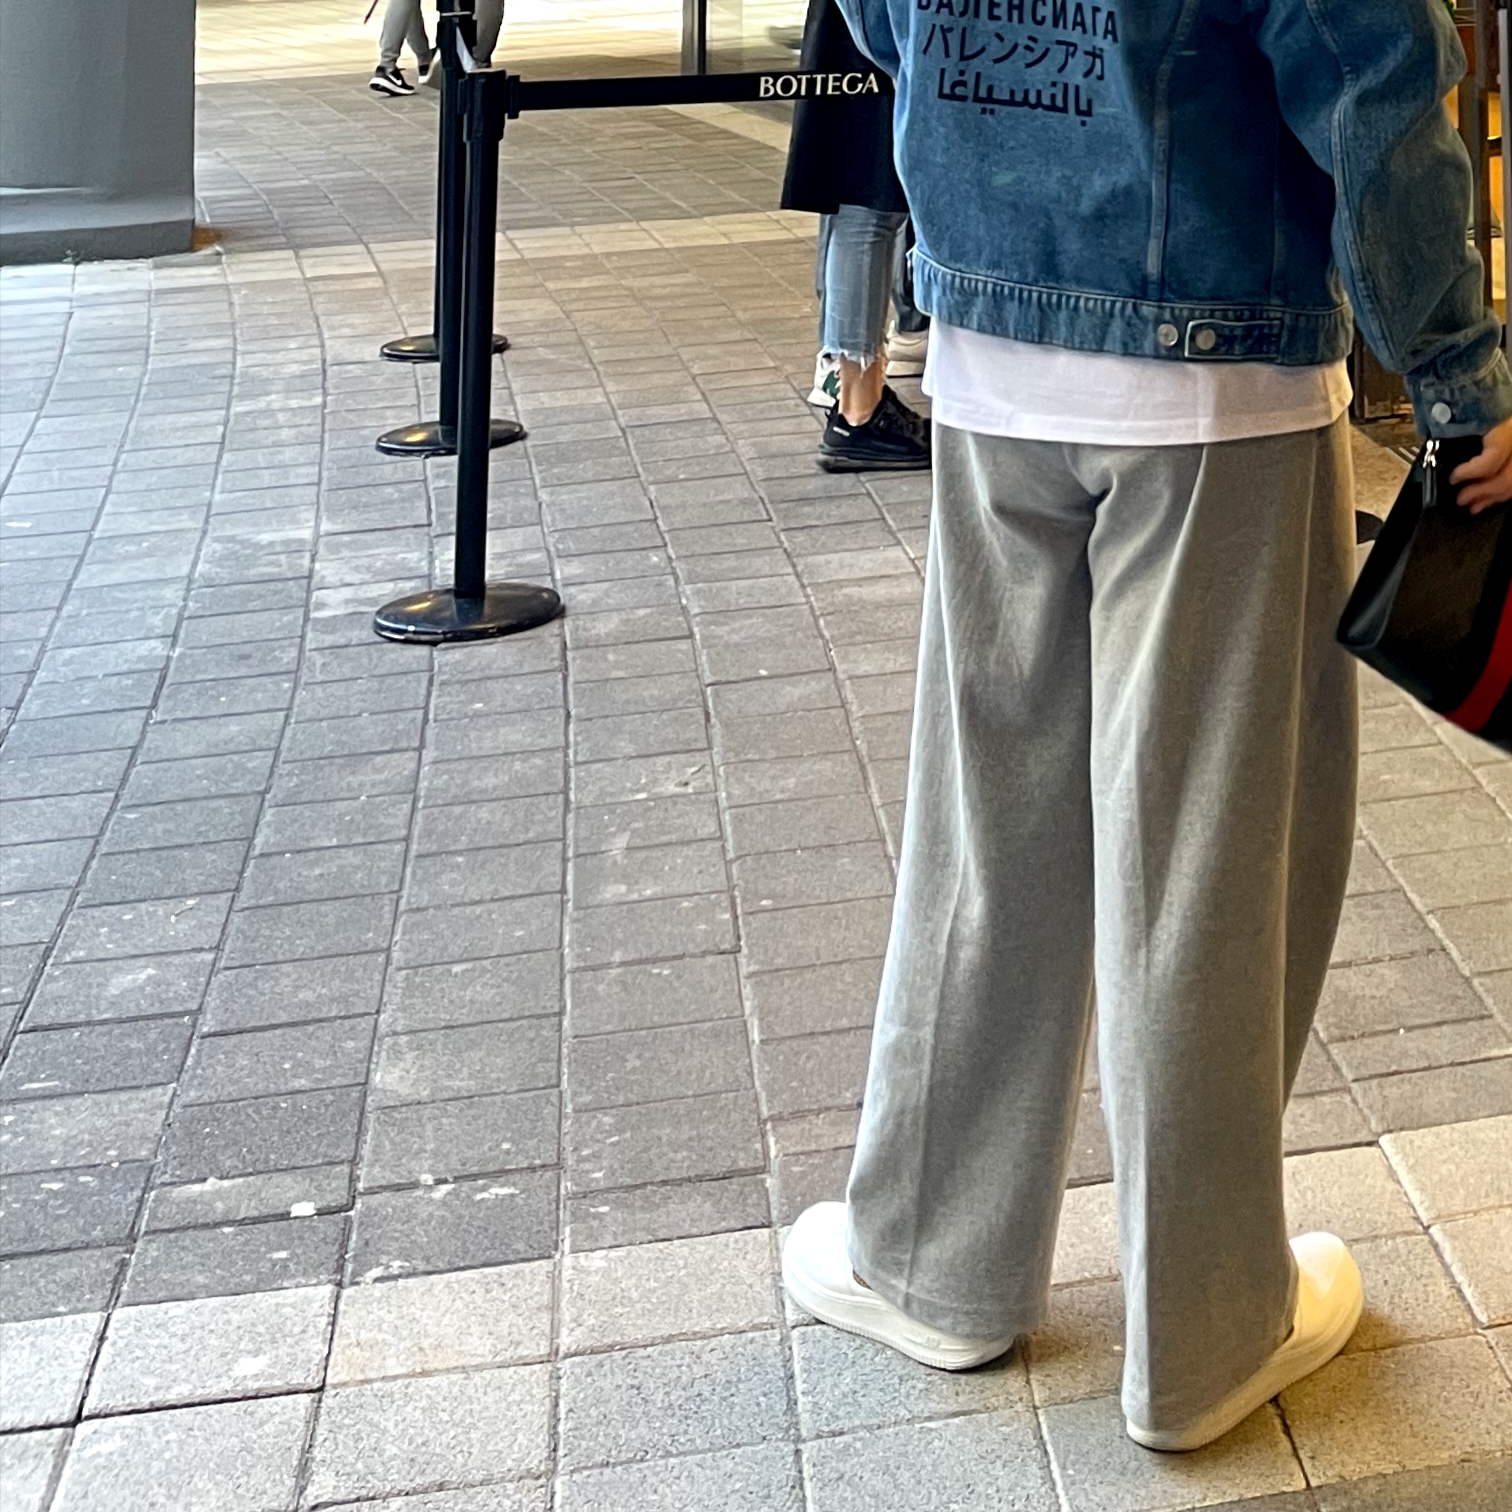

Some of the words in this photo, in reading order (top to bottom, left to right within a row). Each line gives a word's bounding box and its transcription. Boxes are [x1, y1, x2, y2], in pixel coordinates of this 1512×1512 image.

[922, 23, 1106, 81] バレンシアガ
[758, 72, 880, 98] BOTTEGA
